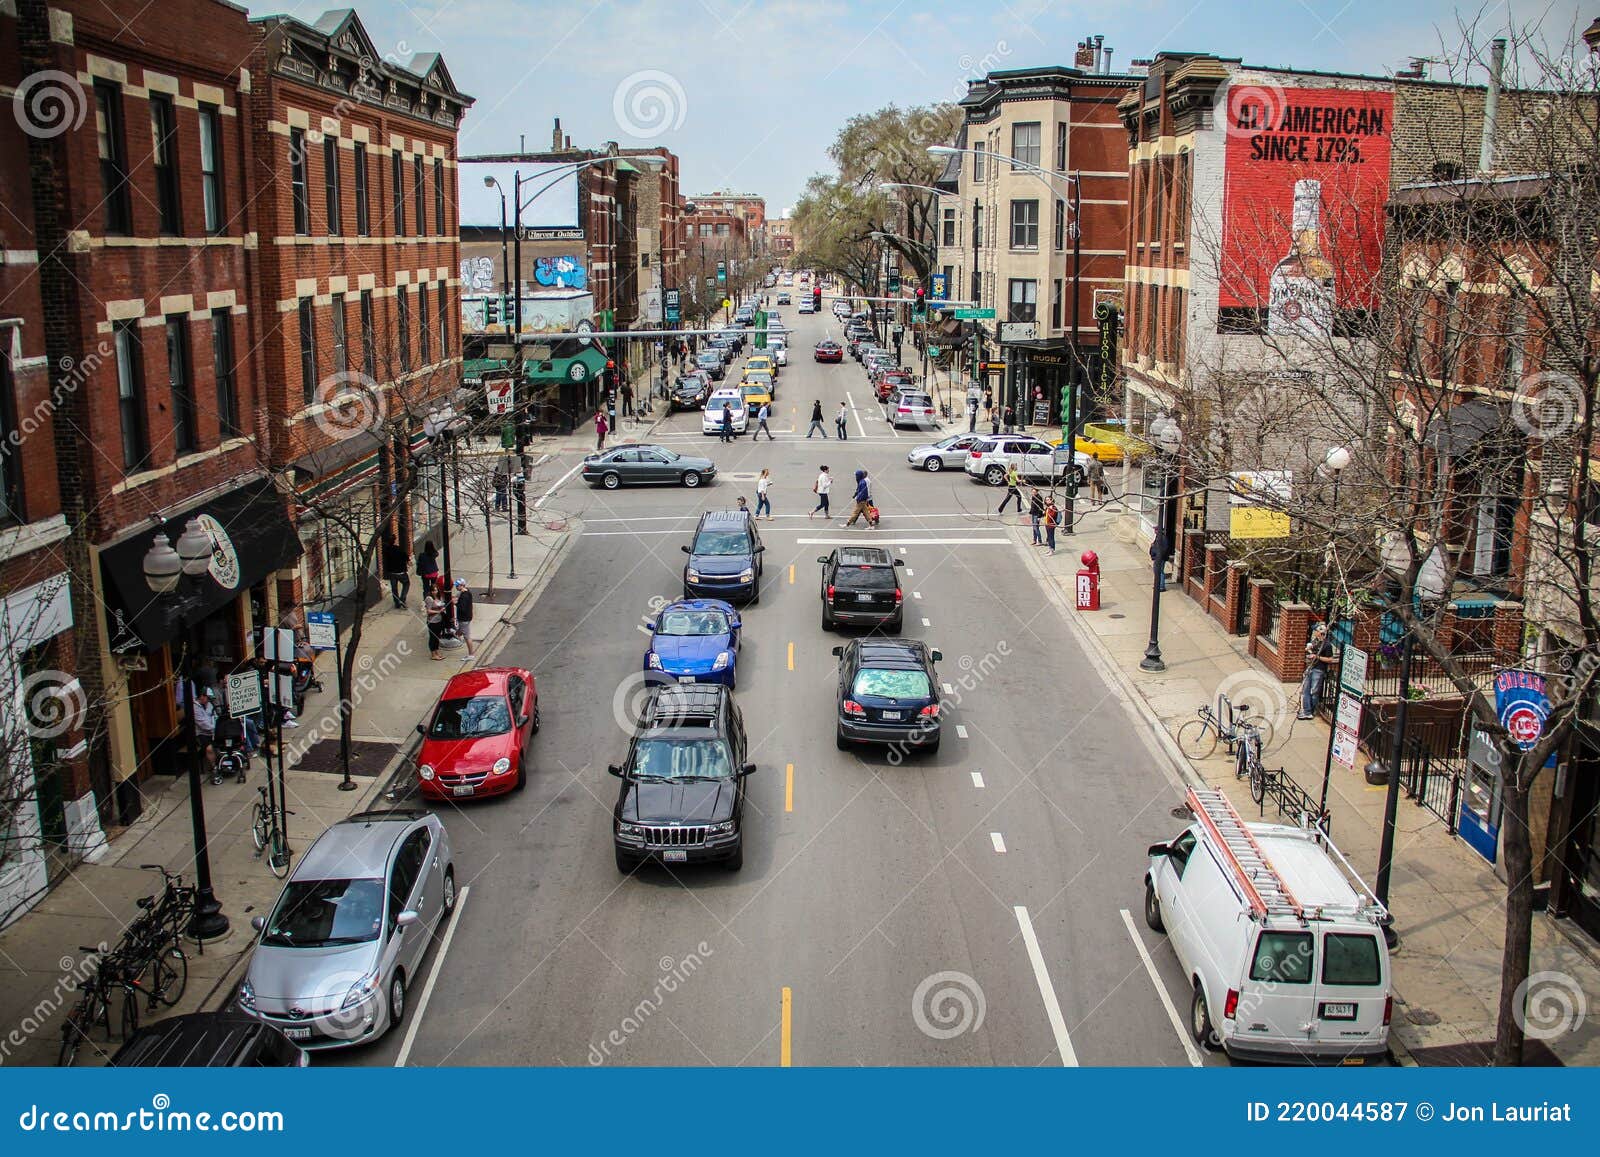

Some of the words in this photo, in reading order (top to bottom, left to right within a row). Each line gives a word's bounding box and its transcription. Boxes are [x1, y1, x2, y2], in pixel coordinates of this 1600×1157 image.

[1237, 104, 1274, 130] ALL
[1280, 106, 1384, 136] AMERICAN
[1250, 134, 1310, 162] SINCE
[1101, 322, 1109, 359] argo
[1078, 575, 1090, 592] R
